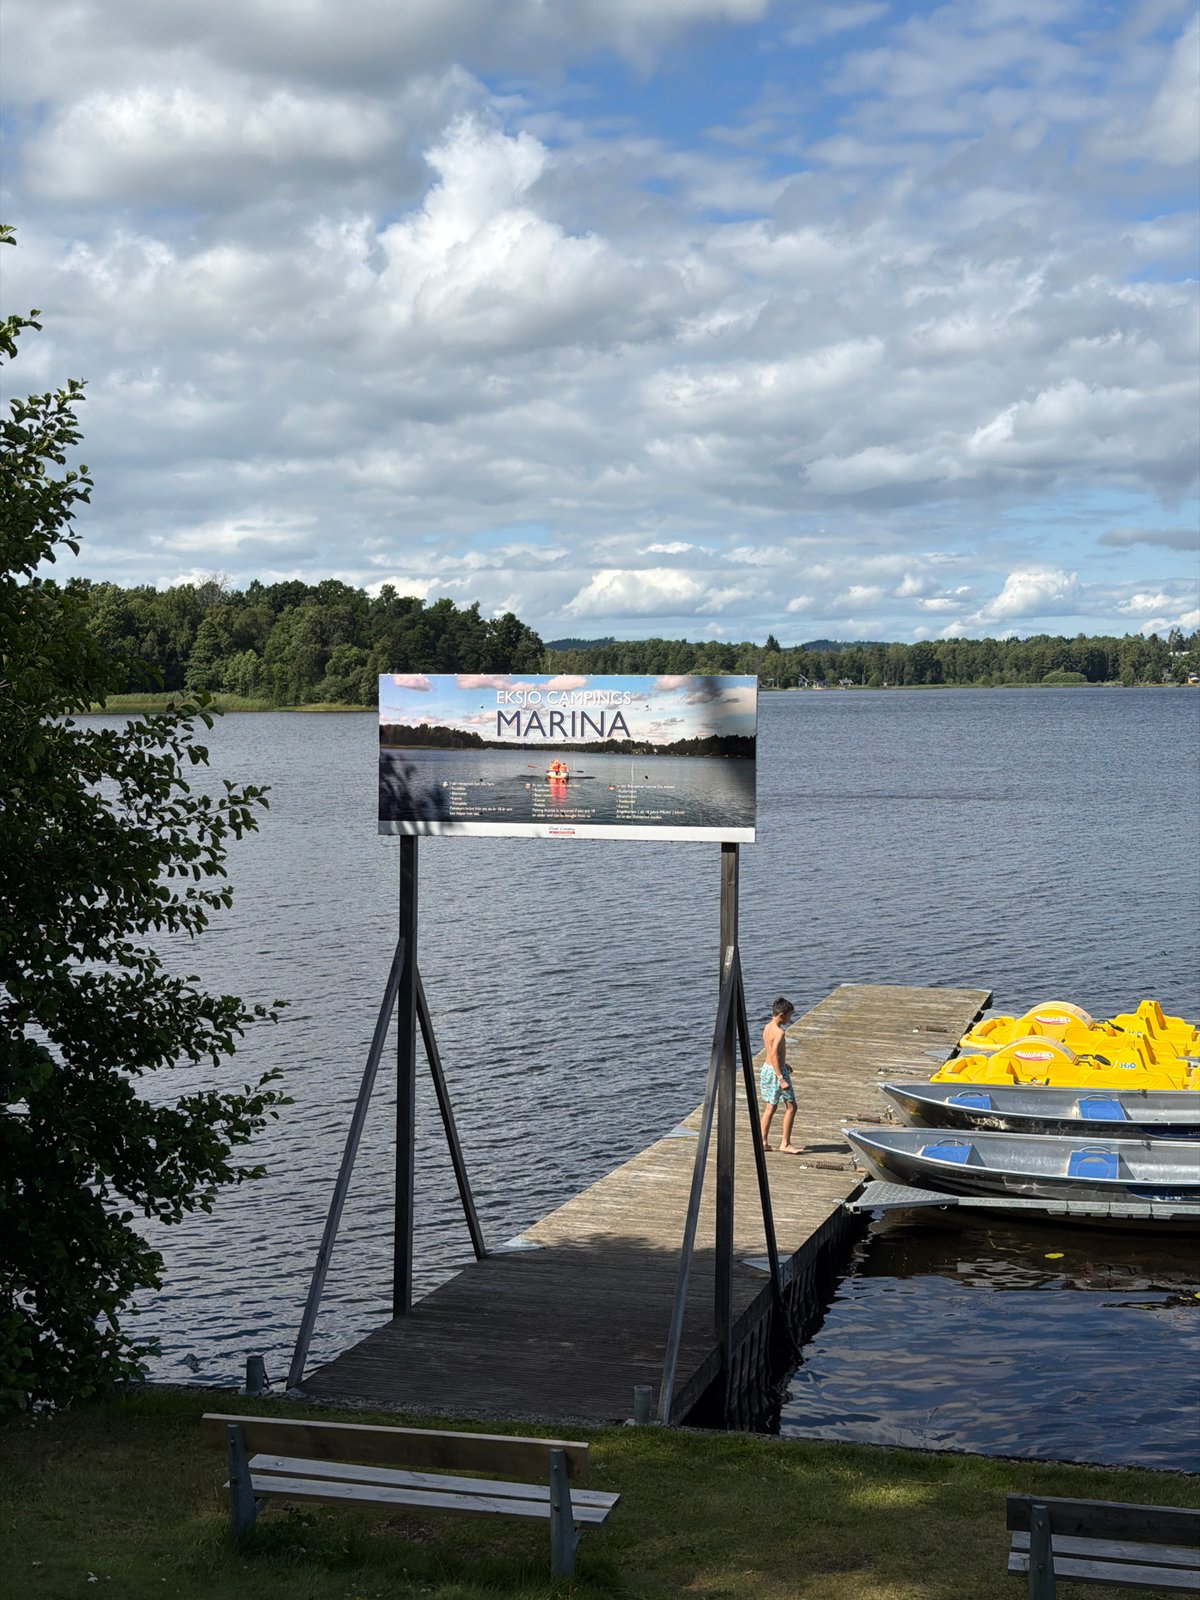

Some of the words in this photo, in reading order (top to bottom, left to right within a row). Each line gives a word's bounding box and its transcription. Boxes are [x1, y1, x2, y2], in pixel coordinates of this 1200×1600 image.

[496, 688, 542, 708] EKSJÖ
[547, 690, 632, 705] CAMPINGS
[497, 710, 631, 738] MARINA
